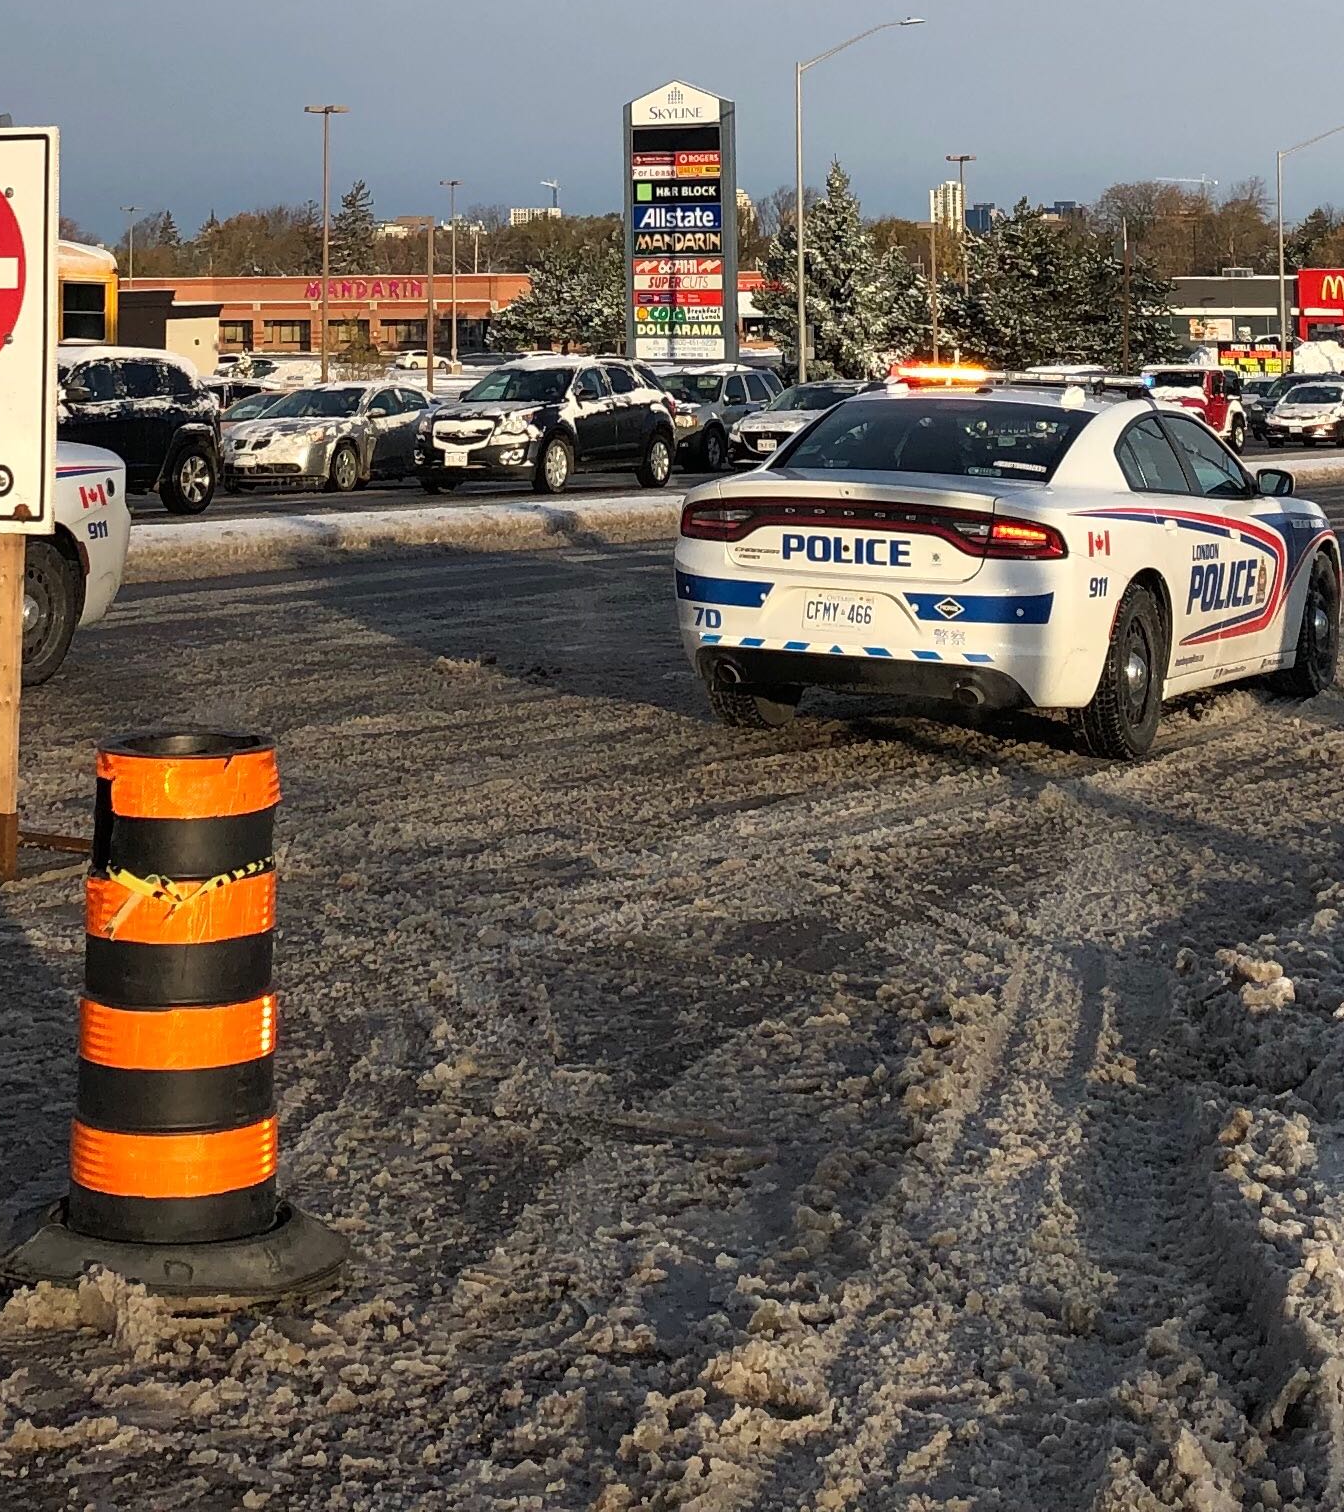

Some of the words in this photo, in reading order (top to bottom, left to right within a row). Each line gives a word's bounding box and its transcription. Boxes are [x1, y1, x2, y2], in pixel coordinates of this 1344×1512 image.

[688, 154, 719, 163] ROGERS
[632, 169, 647, 177] For
[649, 169, 675, 177] Lease
[656, 186, 679, 197] H&R
[681, 185, 717, 196] BLOCK
[636, 232, 721, 252] MANDARIN
[304, 279, 423, 300] MANDARIN
[648, 275, 709, 289] SUPERCUTS
[637, 323, 722, 336] DOLLARAMA
[88, 520, 109, 539] 911
[782, 533, 912, 567] POLICE
[1192, 542, 1220, 562] LONDON
[1089, 576, 1109, 598] 911
[1185, 558, 1258, 615] POLICE
[806, 600, 840, 622] CFMY
[847, 604, 873, 625] 466
